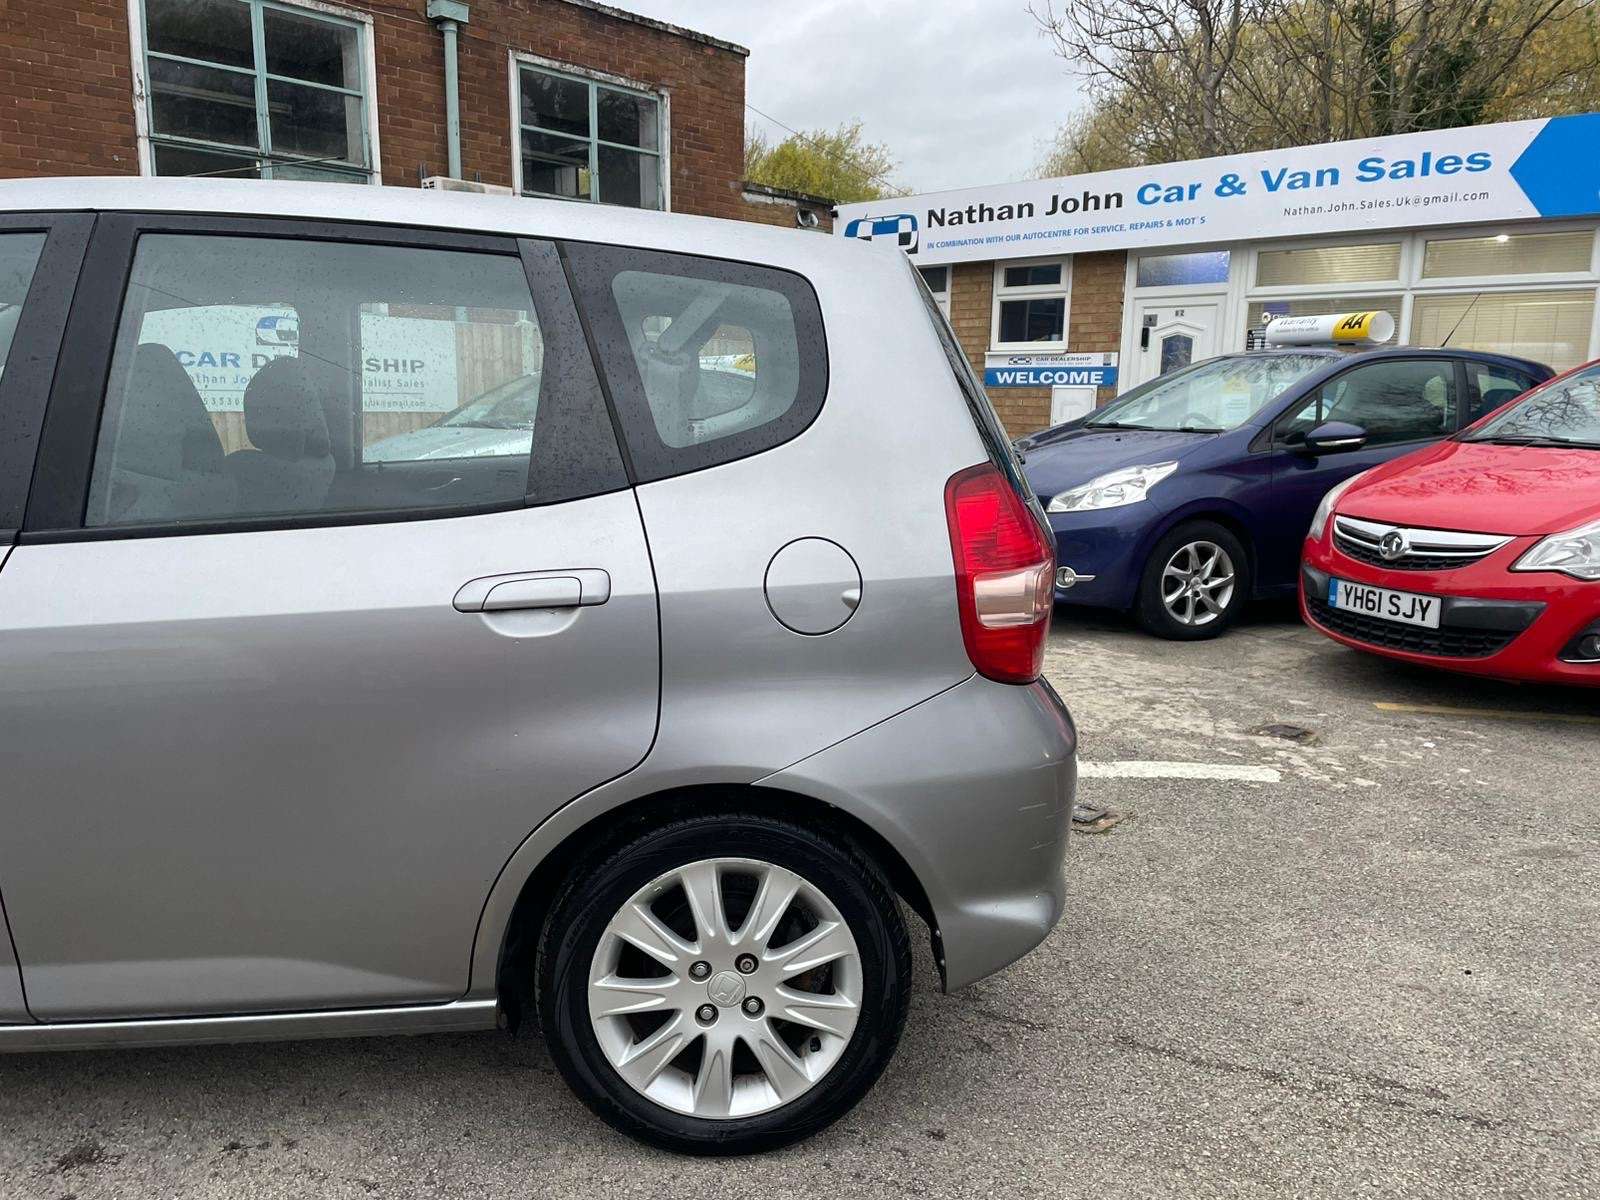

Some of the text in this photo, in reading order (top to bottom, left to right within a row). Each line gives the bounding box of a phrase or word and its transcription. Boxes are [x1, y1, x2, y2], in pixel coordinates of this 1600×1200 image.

[927, 151, 1492, 228] Nathan John Car & Van Sales
[1283, 191, 1489, 216] Nathan.John.Sales.Uk@gmail.com
[927, 241, 935, 249] IN
[936, 237, 984, 248] COMBINATION
[985, 235, 1004, 244] WITH
[1005, 233, 1021, 241] OUR
[1022, 228, 1072, 240] AUTOCENTRE
[1073, 227, 1090, 236] FOR
[1129, 219, 1164, 231] REPAIRS
[1166, 219, 1174, 227] &
[1341, 313, 1369, 330] AA
[176, 350, 241, 368] CAR
[396, 378, 425, 388] Sales
[995, 371, 1104, 384] WELCOME
[1344, 584, 1432, 622] YH61 SJY
